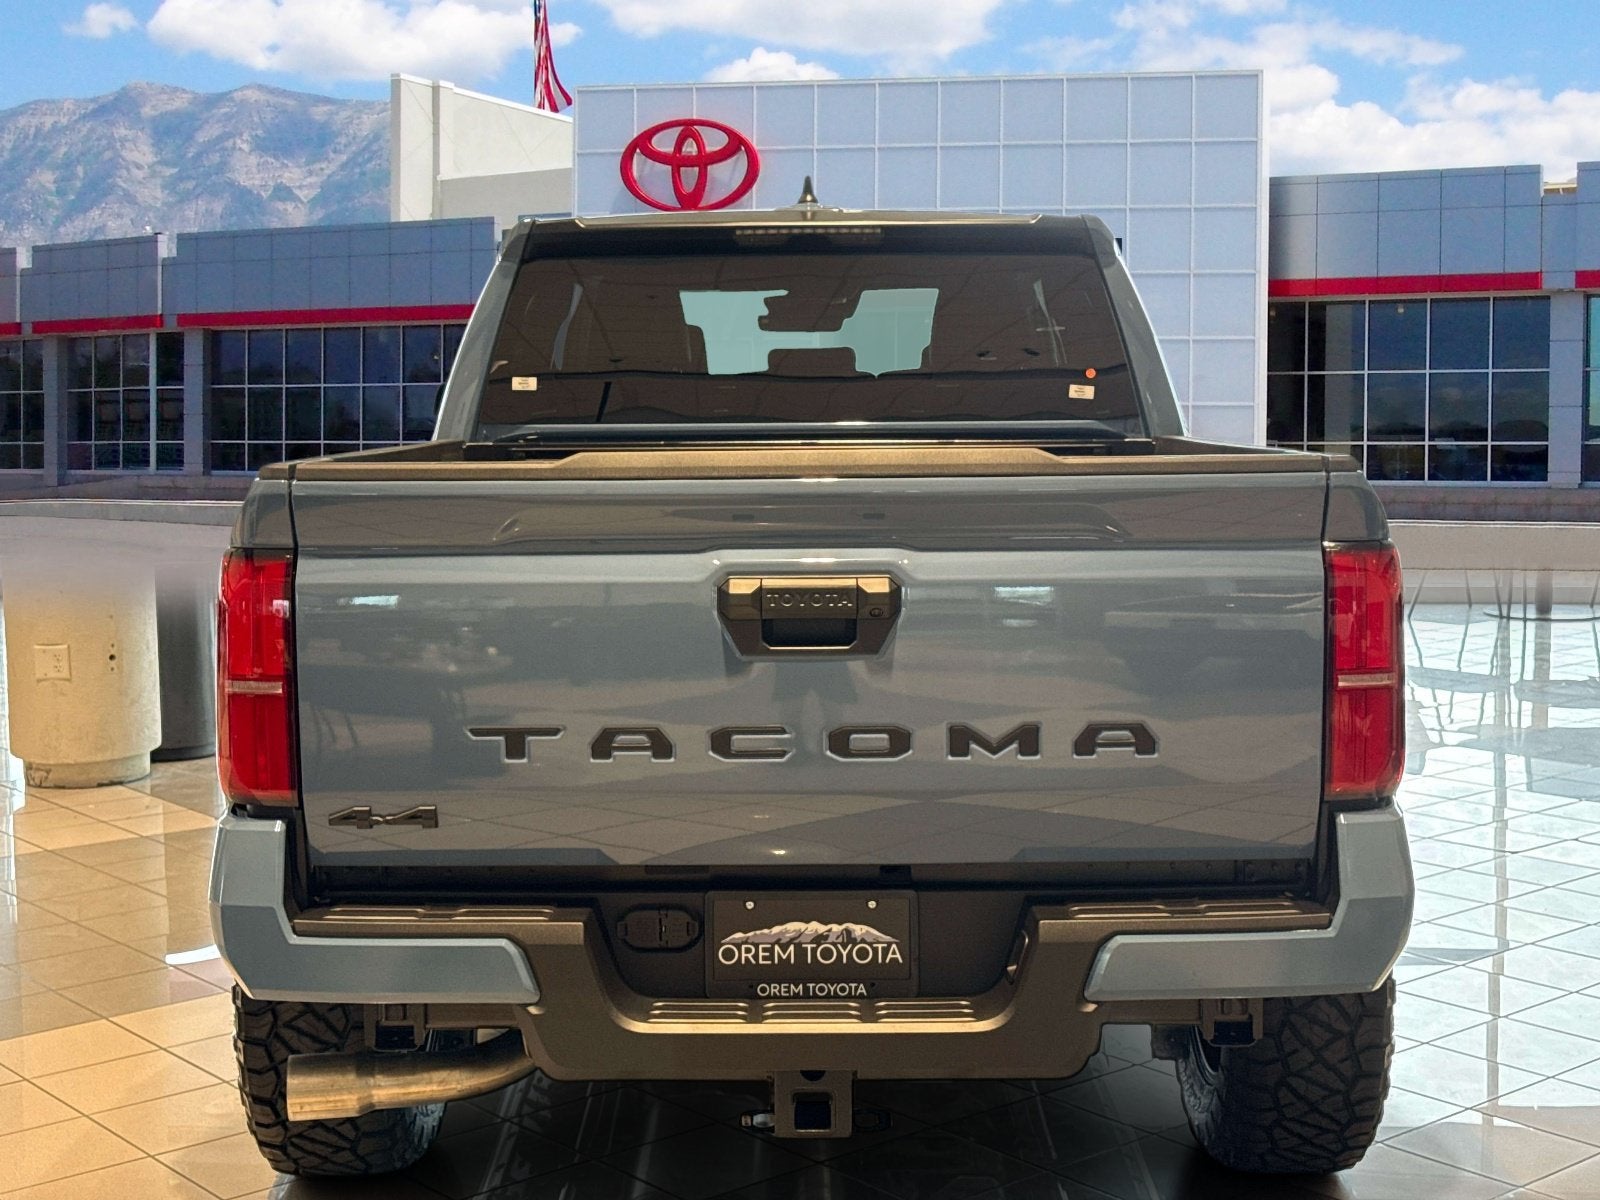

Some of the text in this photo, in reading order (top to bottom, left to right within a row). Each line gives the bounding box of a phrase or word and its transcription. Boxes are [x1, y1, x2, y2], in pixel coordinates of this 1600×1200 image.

[766, 593, 854, 607] TOYOTA
[466, 722, 1161, 763] TACOMA
[718, 943, 903, 965] OREM TOYOTA
[756, 983, 867, 997] OREM TOYOTA
